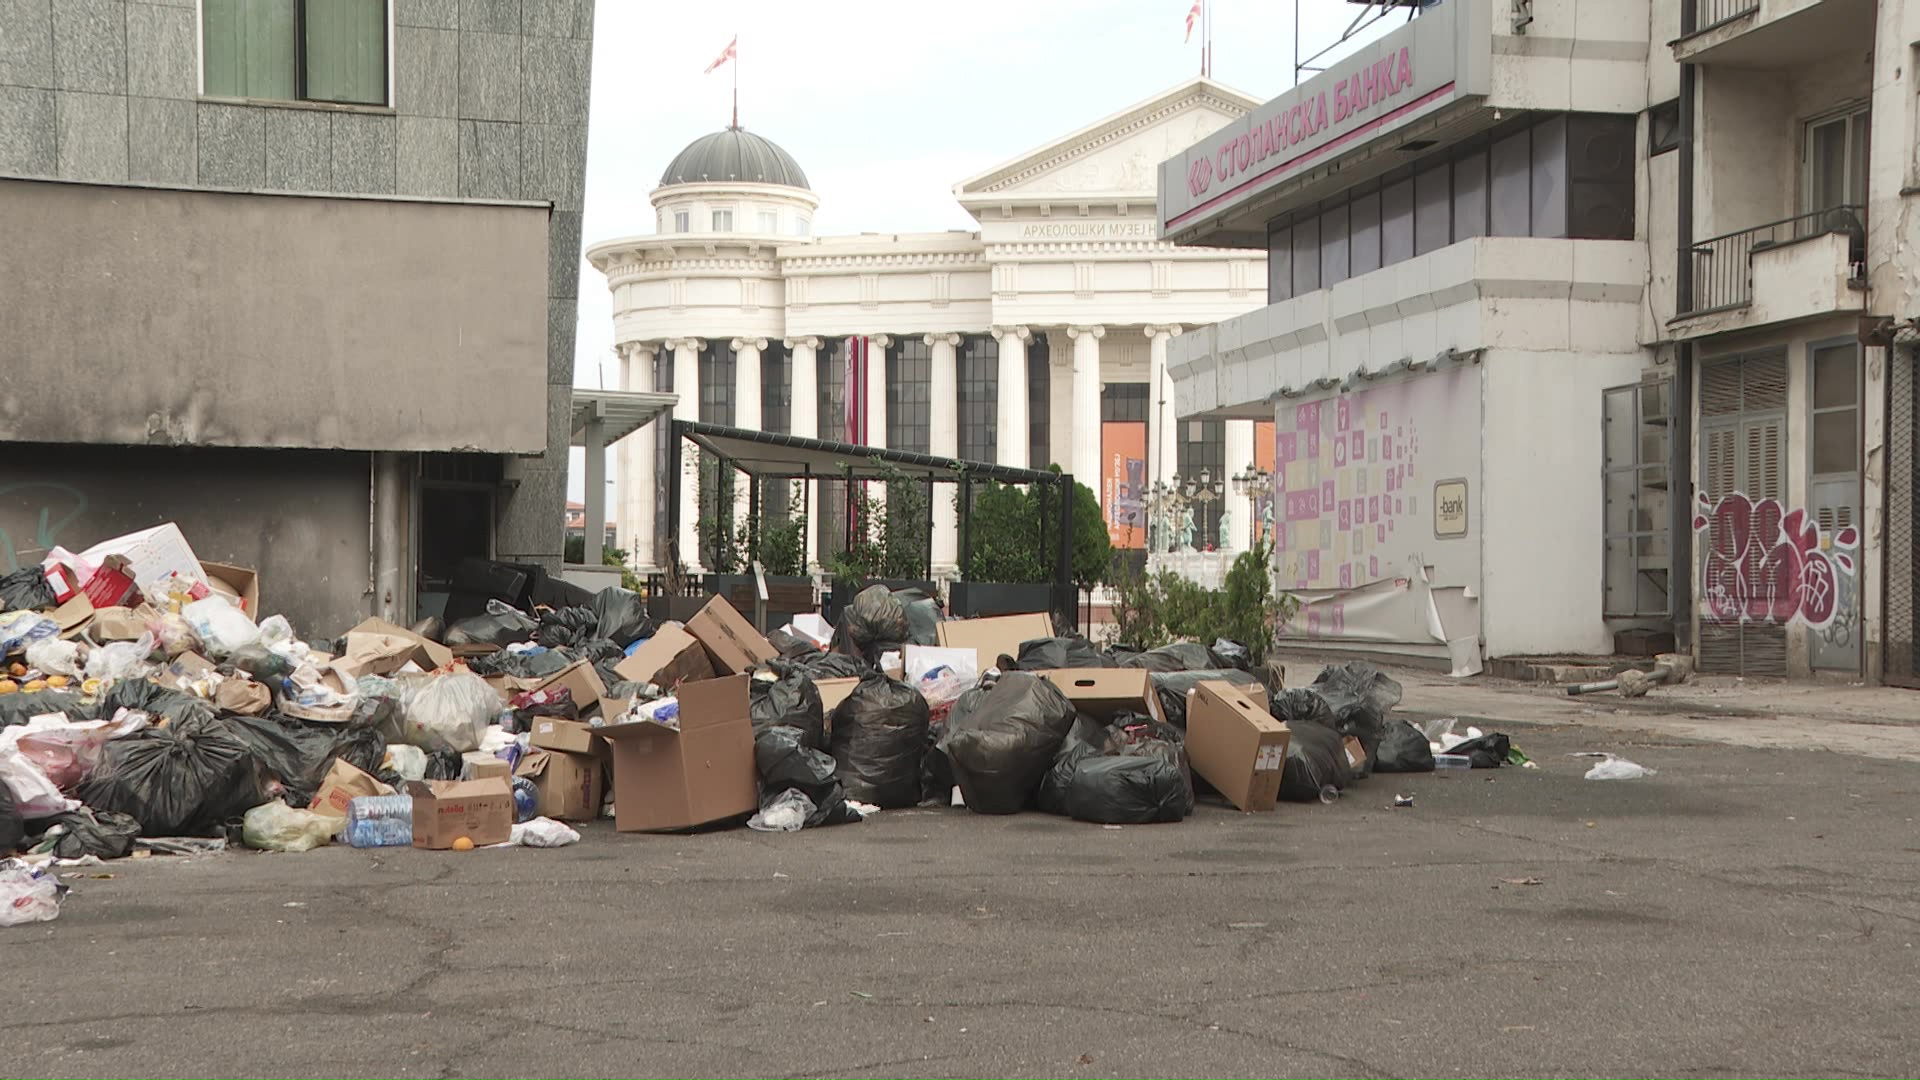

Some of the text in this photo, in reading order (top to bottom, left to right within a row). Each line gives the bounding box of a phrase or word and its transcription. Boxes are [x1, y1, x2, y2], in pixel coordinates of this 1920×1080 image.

[1215, 46, 1413, 182] СТОПАНСКА БАНКА
[1024, 224, 1105, 237] АРХЕОЛОШКИ
[1109, 223, 1146, 236] МУЗЕЈ
